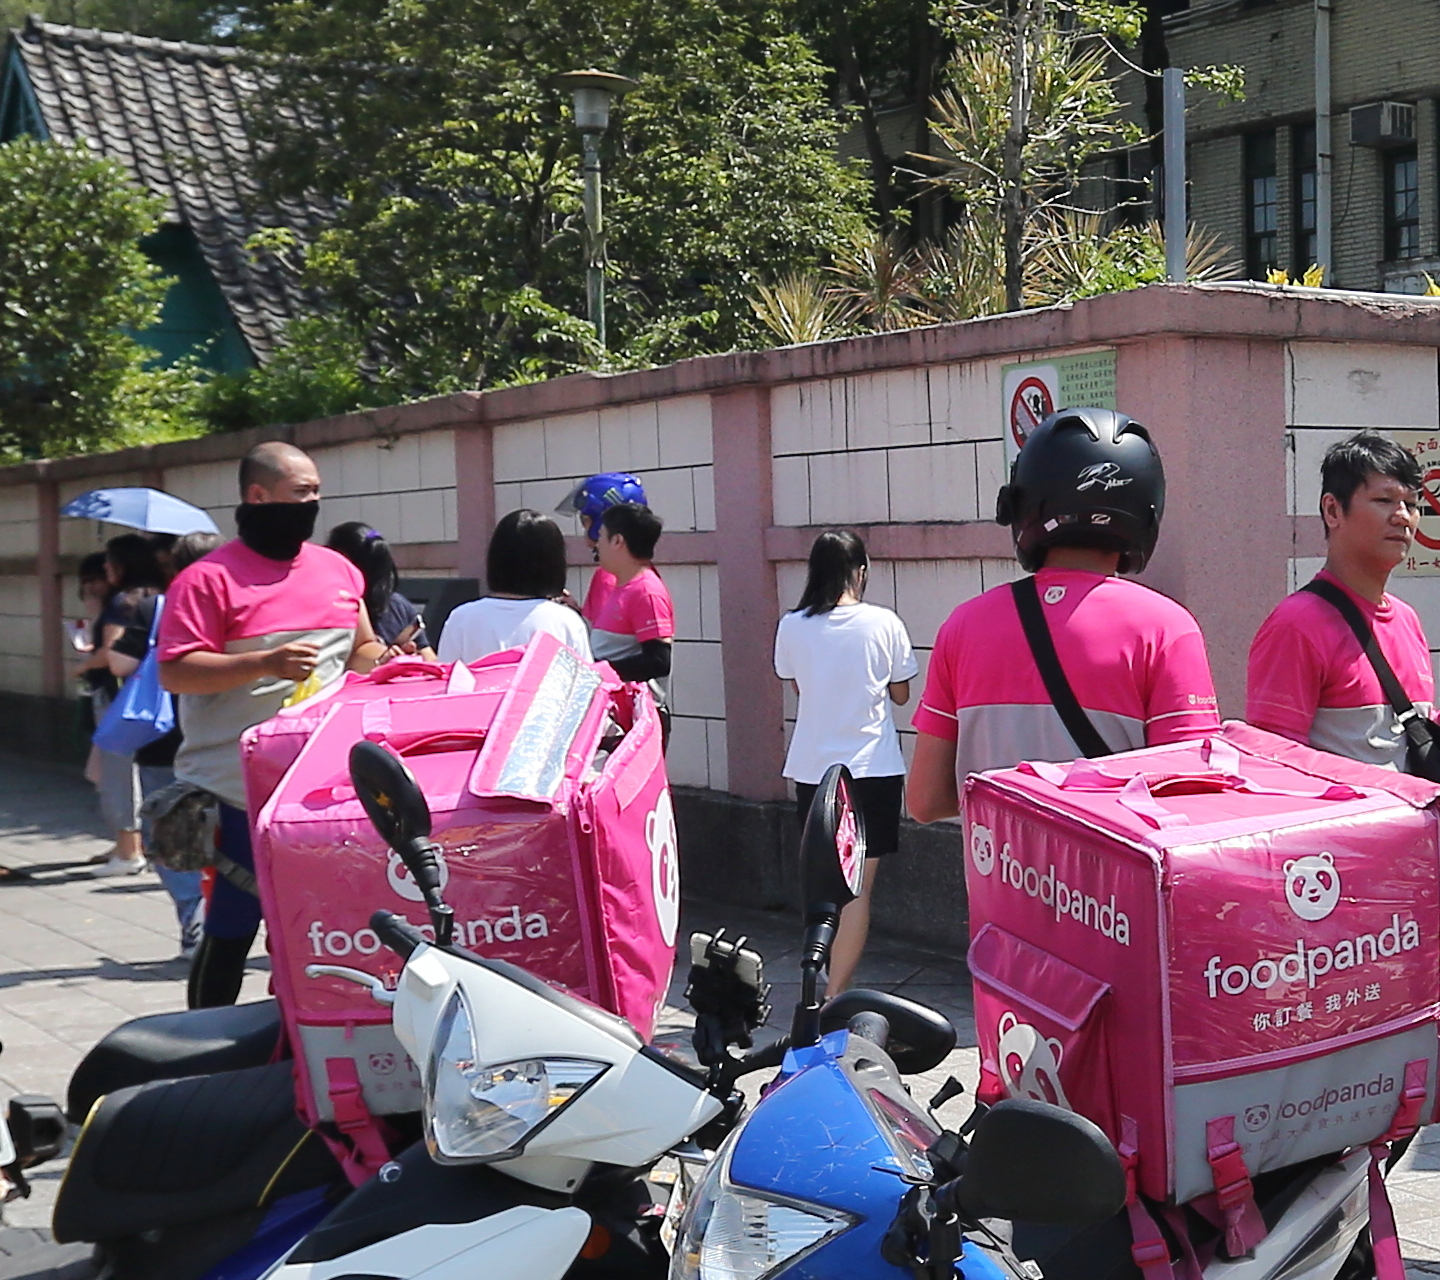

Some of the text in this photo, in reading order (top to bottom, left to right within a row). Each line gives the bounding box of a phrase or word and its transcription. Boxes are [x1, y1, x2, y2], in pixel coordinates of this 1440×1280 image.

[1001, 842, 1131, 947] foodpanda
[307, 905, 549, 958] fooanda
[1204, 914, 1421, 998] foodpanda
[1252, 983, 1382, 1033] 你訂餐 我外送
